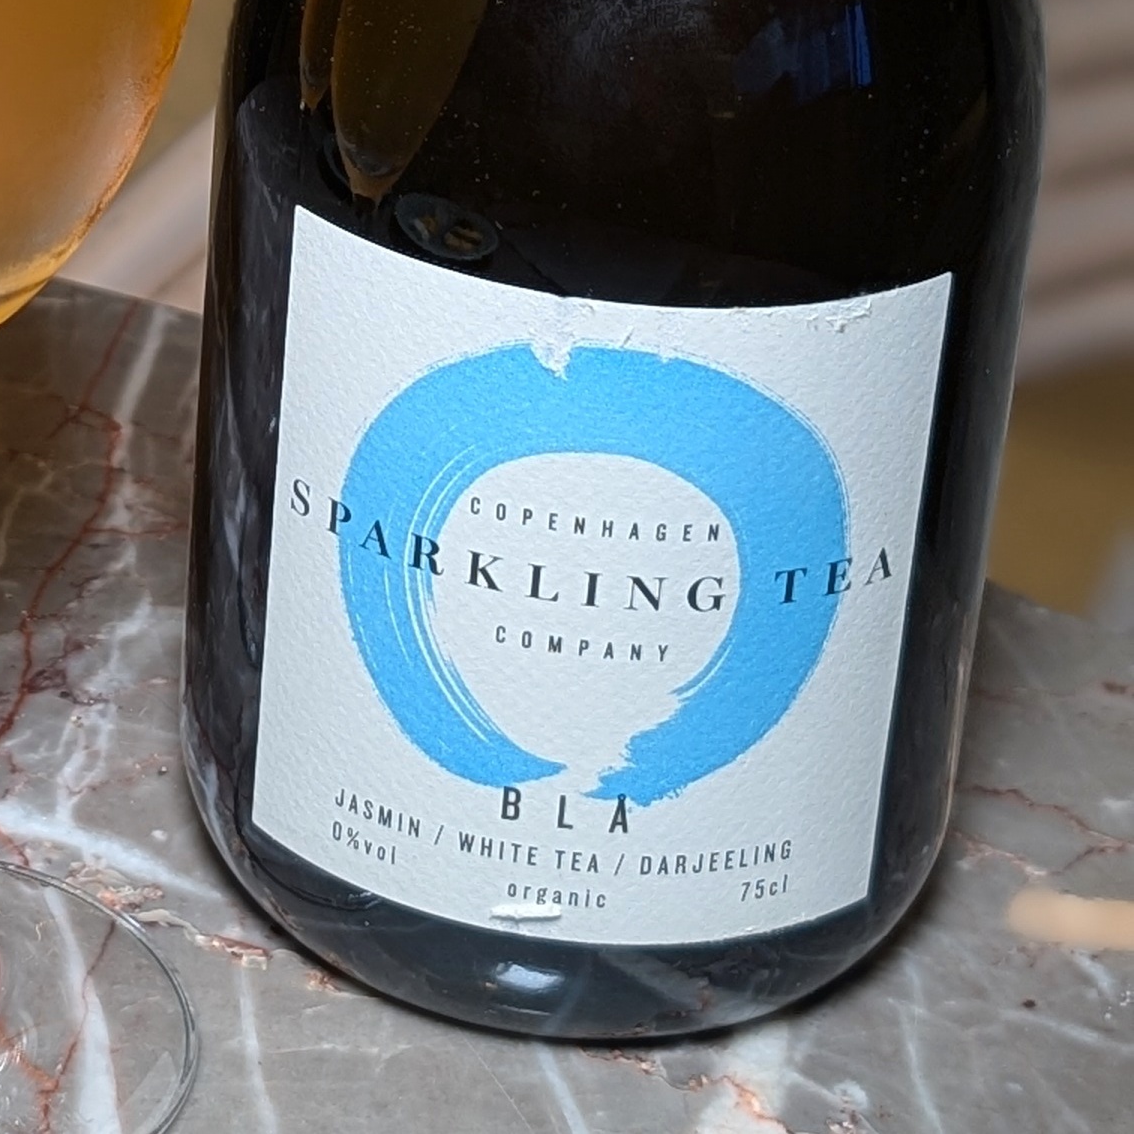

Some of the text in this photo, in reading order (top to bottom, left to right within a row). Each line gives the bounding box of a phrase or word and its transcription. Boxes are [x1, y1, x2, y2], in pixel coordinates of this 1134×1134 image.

[469, 496, 722, 543] COPENHAGEN
[289, 478, 893, 613] SPARKLING TEA
[495, 625, 670, 663] COMPANY
[335, 788, 420, 838] JASMIN
[458, 833, 538, 867] WHITE
[555, 850, 601, 874] TEA
[640, 839, 792, 876] DARJEELING
[500, 786, 629, 834] BLÅ
[331, 821, 397, 865] 0%vol
[507, 881, 607, 910] organic
[739, 875, 788, 902] 75cl
